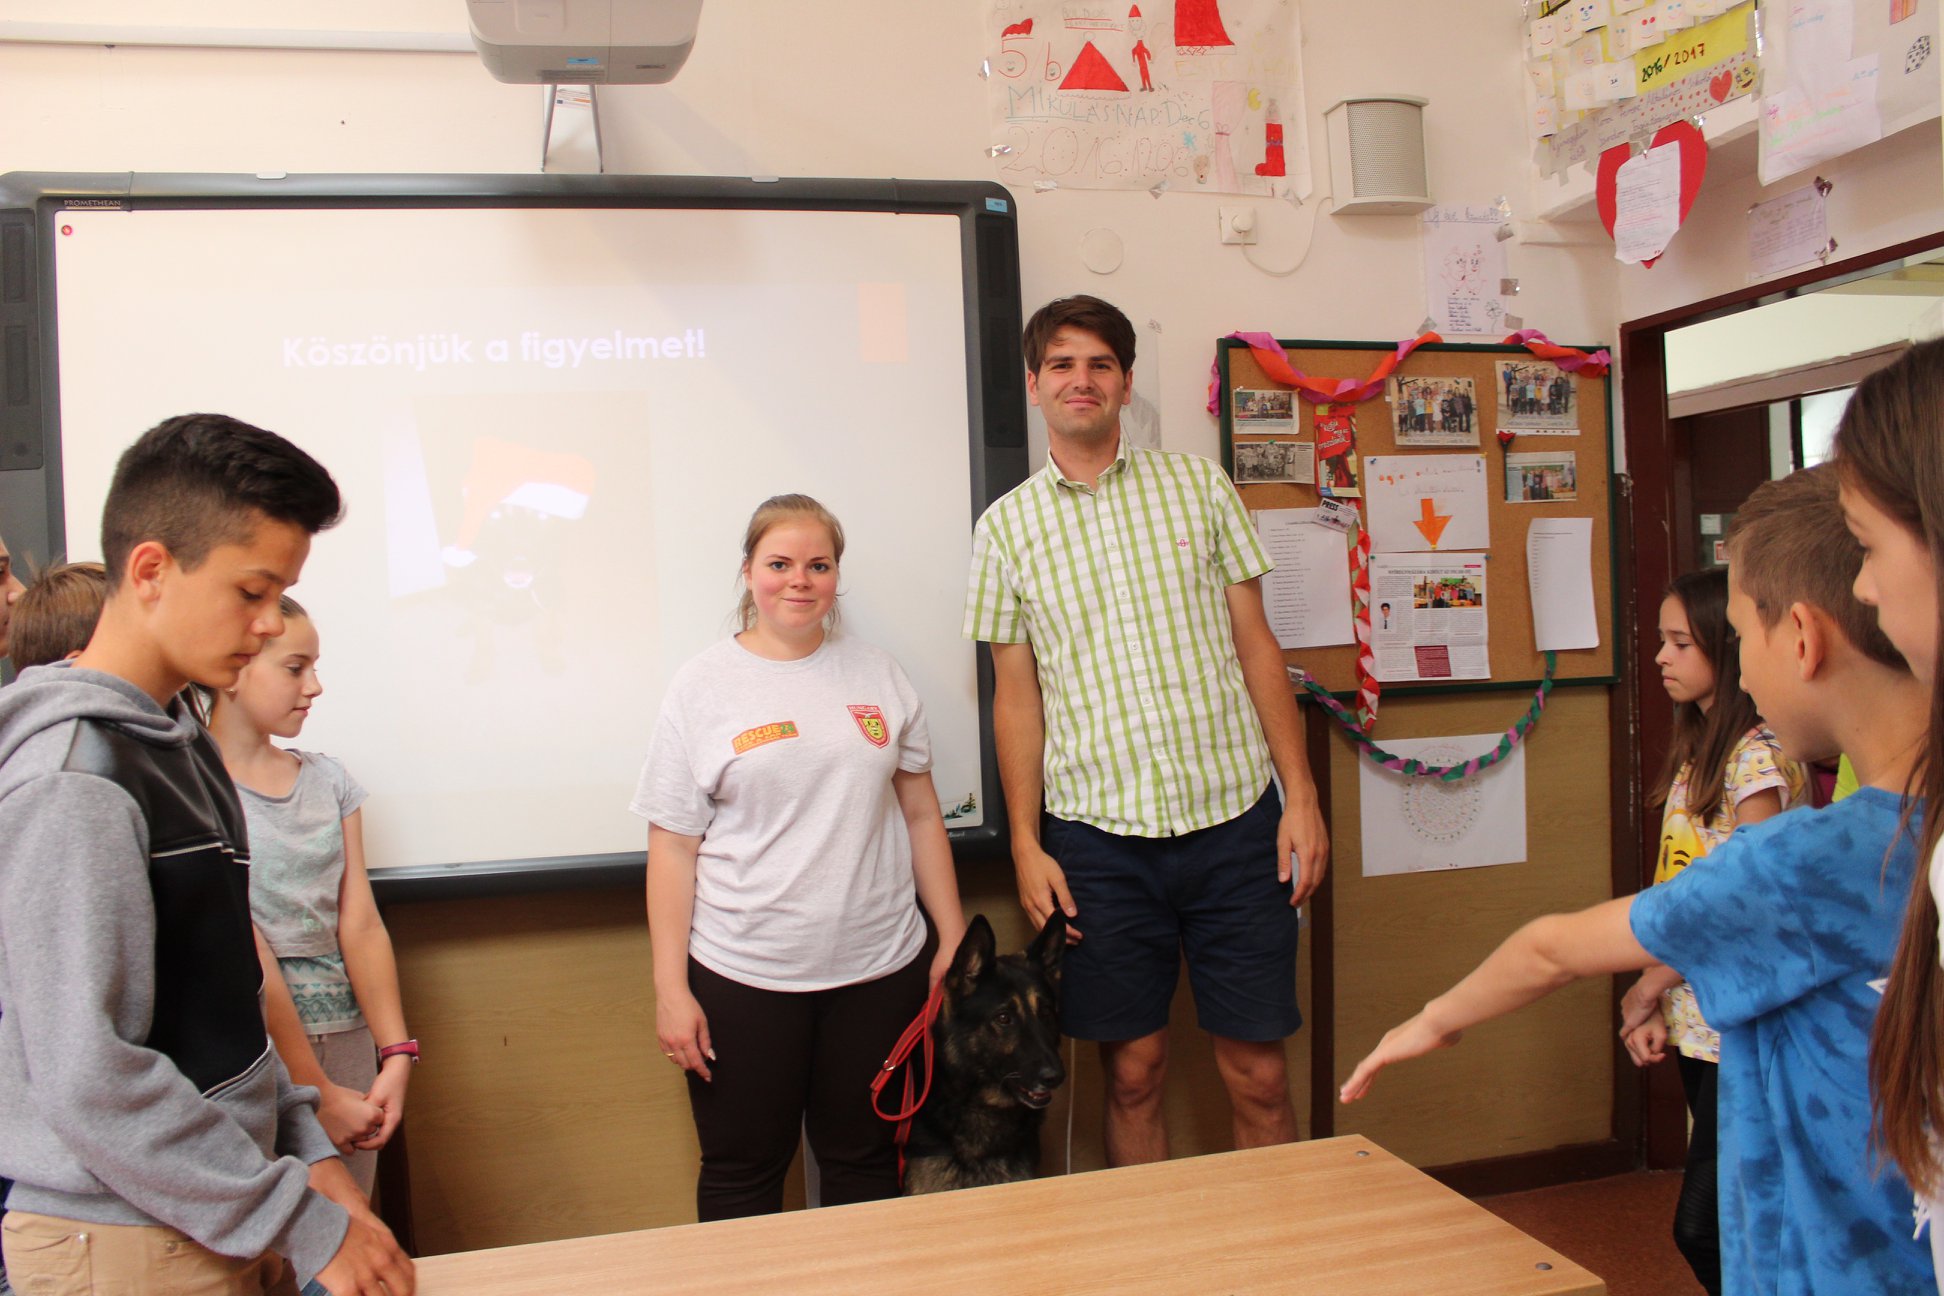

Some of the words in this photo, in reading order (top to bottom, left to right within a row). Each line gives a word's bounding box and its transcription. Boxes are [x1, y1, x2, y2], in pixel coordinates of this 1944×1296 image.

[64, 199, 121, 207] PROMETHEAN
[283, 334, 474, 371] Köszönjük
[486, 338, 509, 362] a
[520, 328, 707, 368] figyelmet!
[1321, 500, 1340, 511] PRESS
